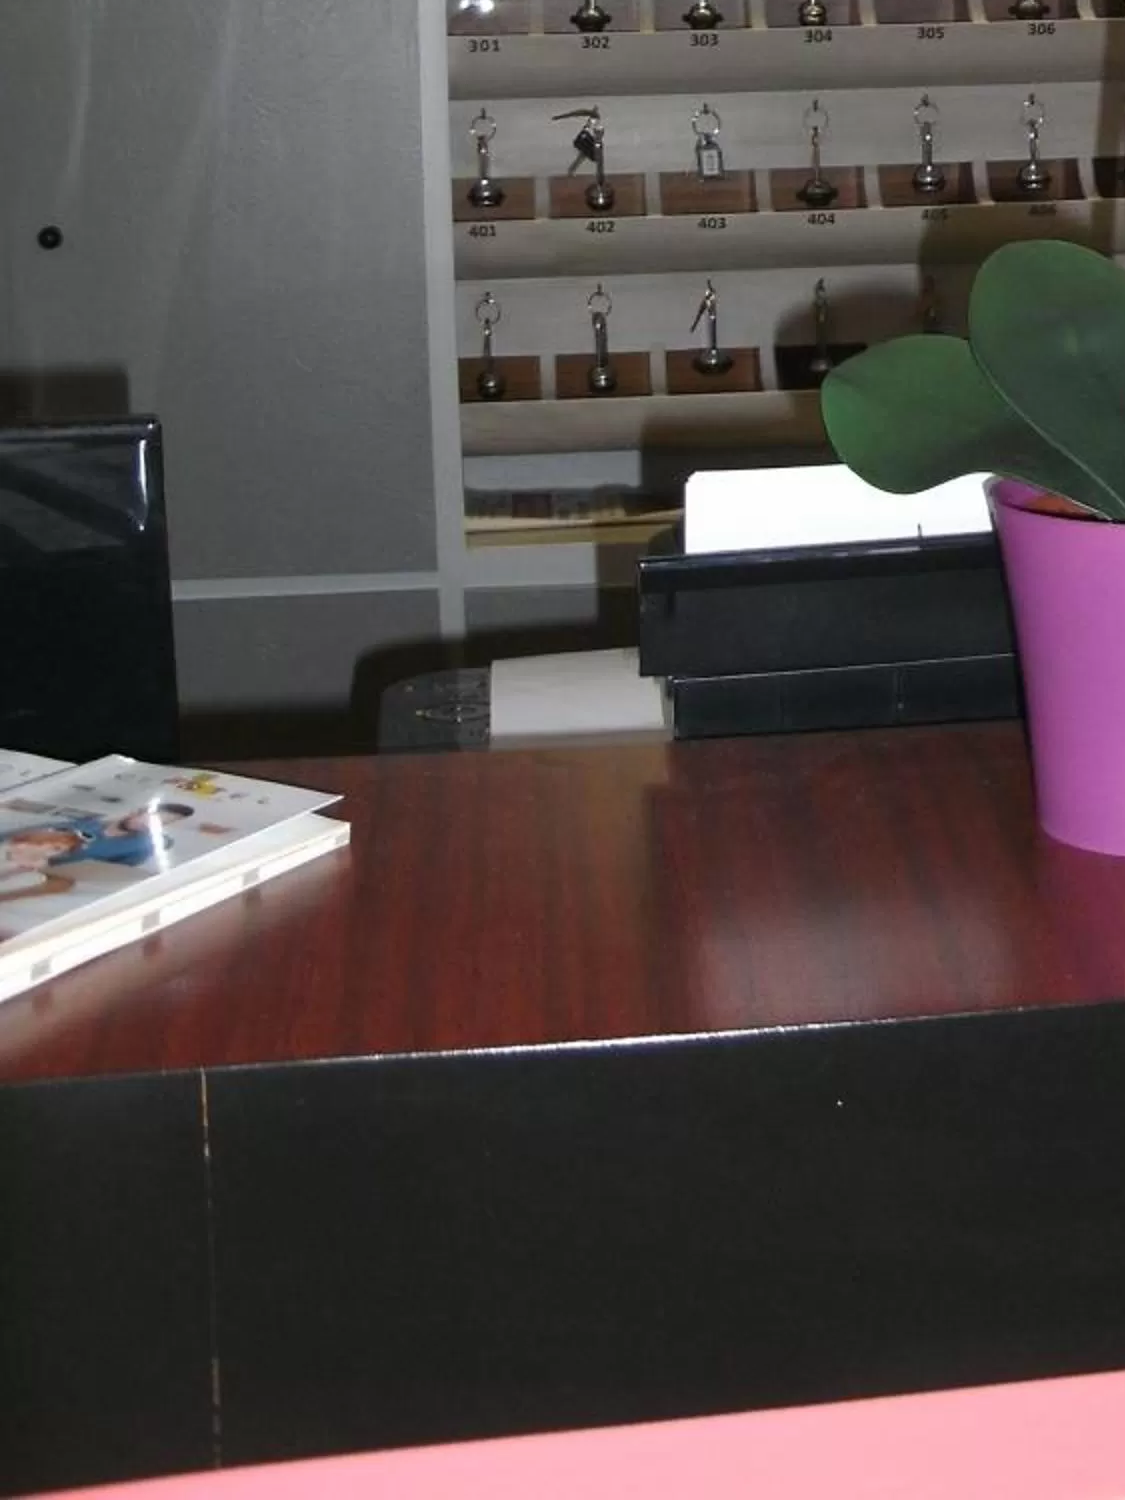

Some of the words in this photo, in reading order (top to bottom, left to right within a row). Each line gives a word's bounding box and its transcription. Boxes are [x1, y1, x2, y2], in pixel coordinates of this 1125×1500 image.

[469, 39, 500, 53] 301
[581, 35, 610, 49] 302
[690, 33, 719, 47] 303
[804, 29, 832, 44] 304
[917, 26, 945, 40] 305
[1027, 22, 1056, 36] 306
[469, 225, 497, 238] 401
[586, 220, 615, 234] 402
[698, 216, 727, 230] 403
[807, 213, 835, 226] 404
